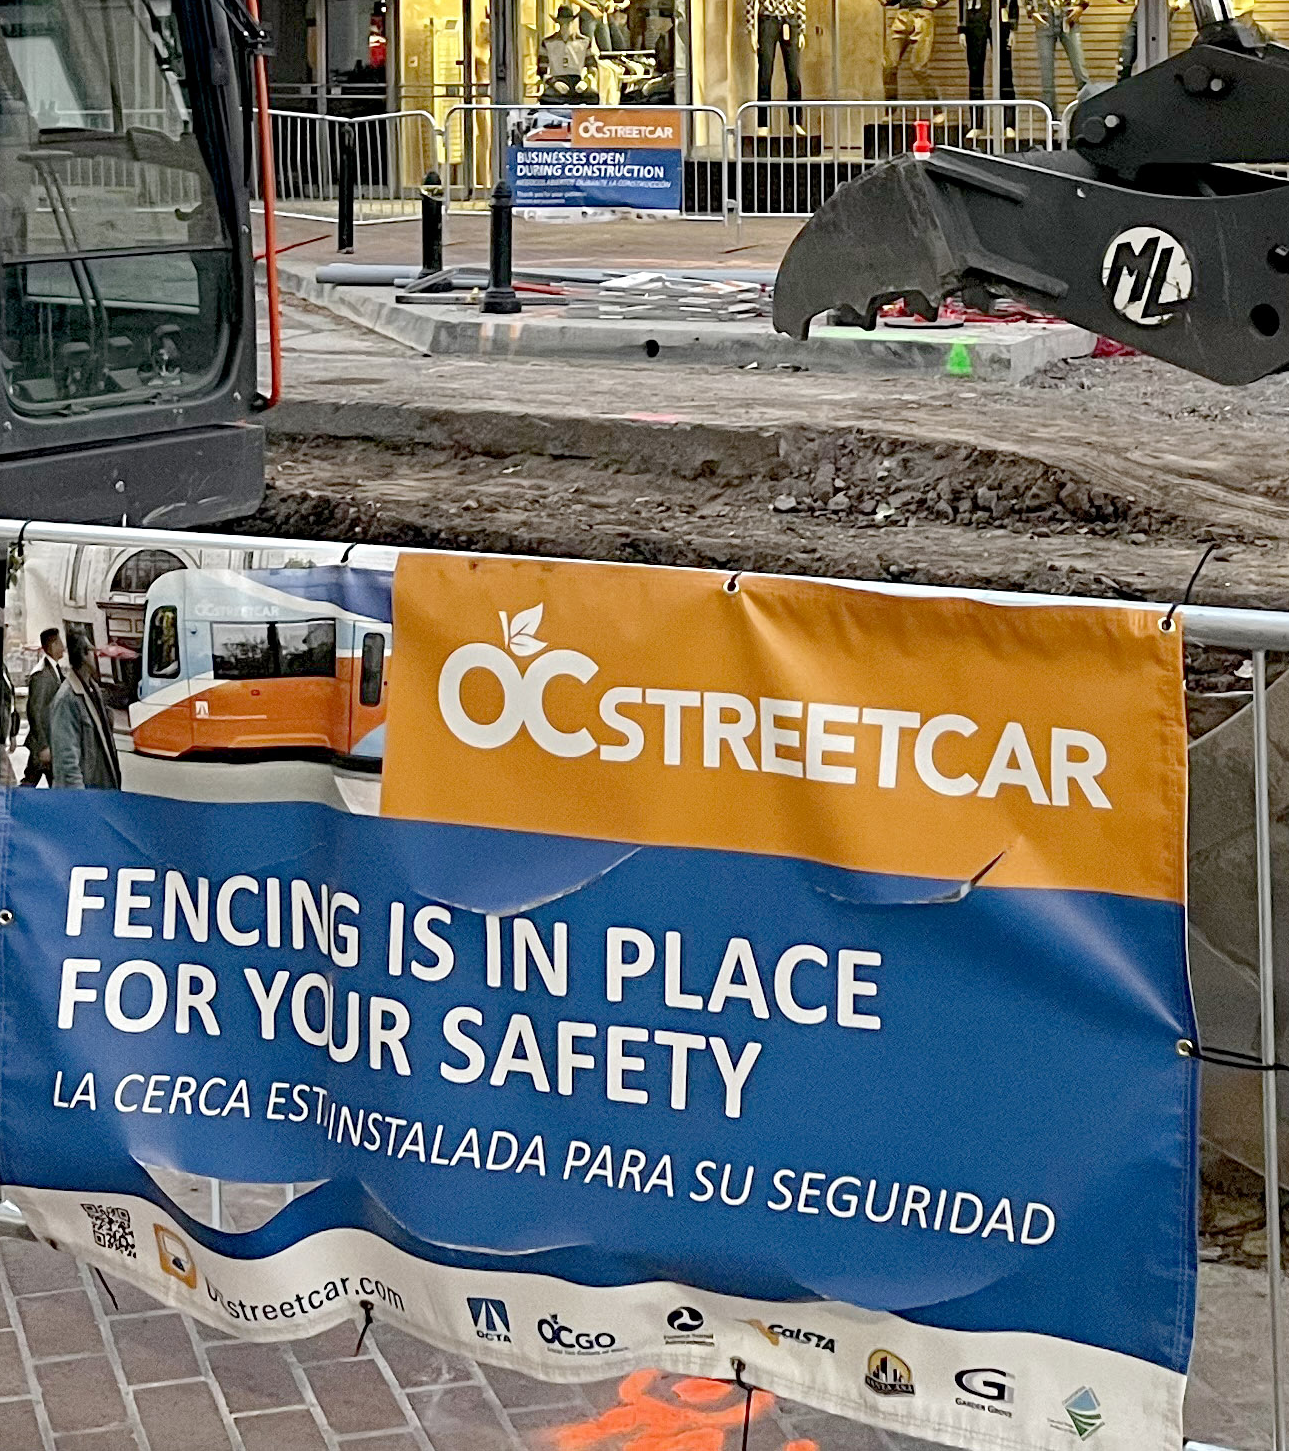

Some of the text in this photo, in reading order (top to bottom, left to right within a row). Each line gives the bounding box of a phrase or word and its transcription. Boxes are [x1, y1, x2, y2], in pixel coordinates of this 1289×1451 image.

[516, 151, 625, 165] BUSINESSES OPEN
[516, 164, 664, 178] DURING CONSTRUCTION
[65, 866, 881, 1031] FENCING IS IN PLACE
[57, 958, 762, 1119] FOR YOUR SAFETY
[52, 1070, 1056, 1246] LA CERCA EST INSTALADA PARA SU SEGURIDAD
[476, 1328, 512, 1344] OCTA
[768, 1324, 836, 1353] CalSTA
